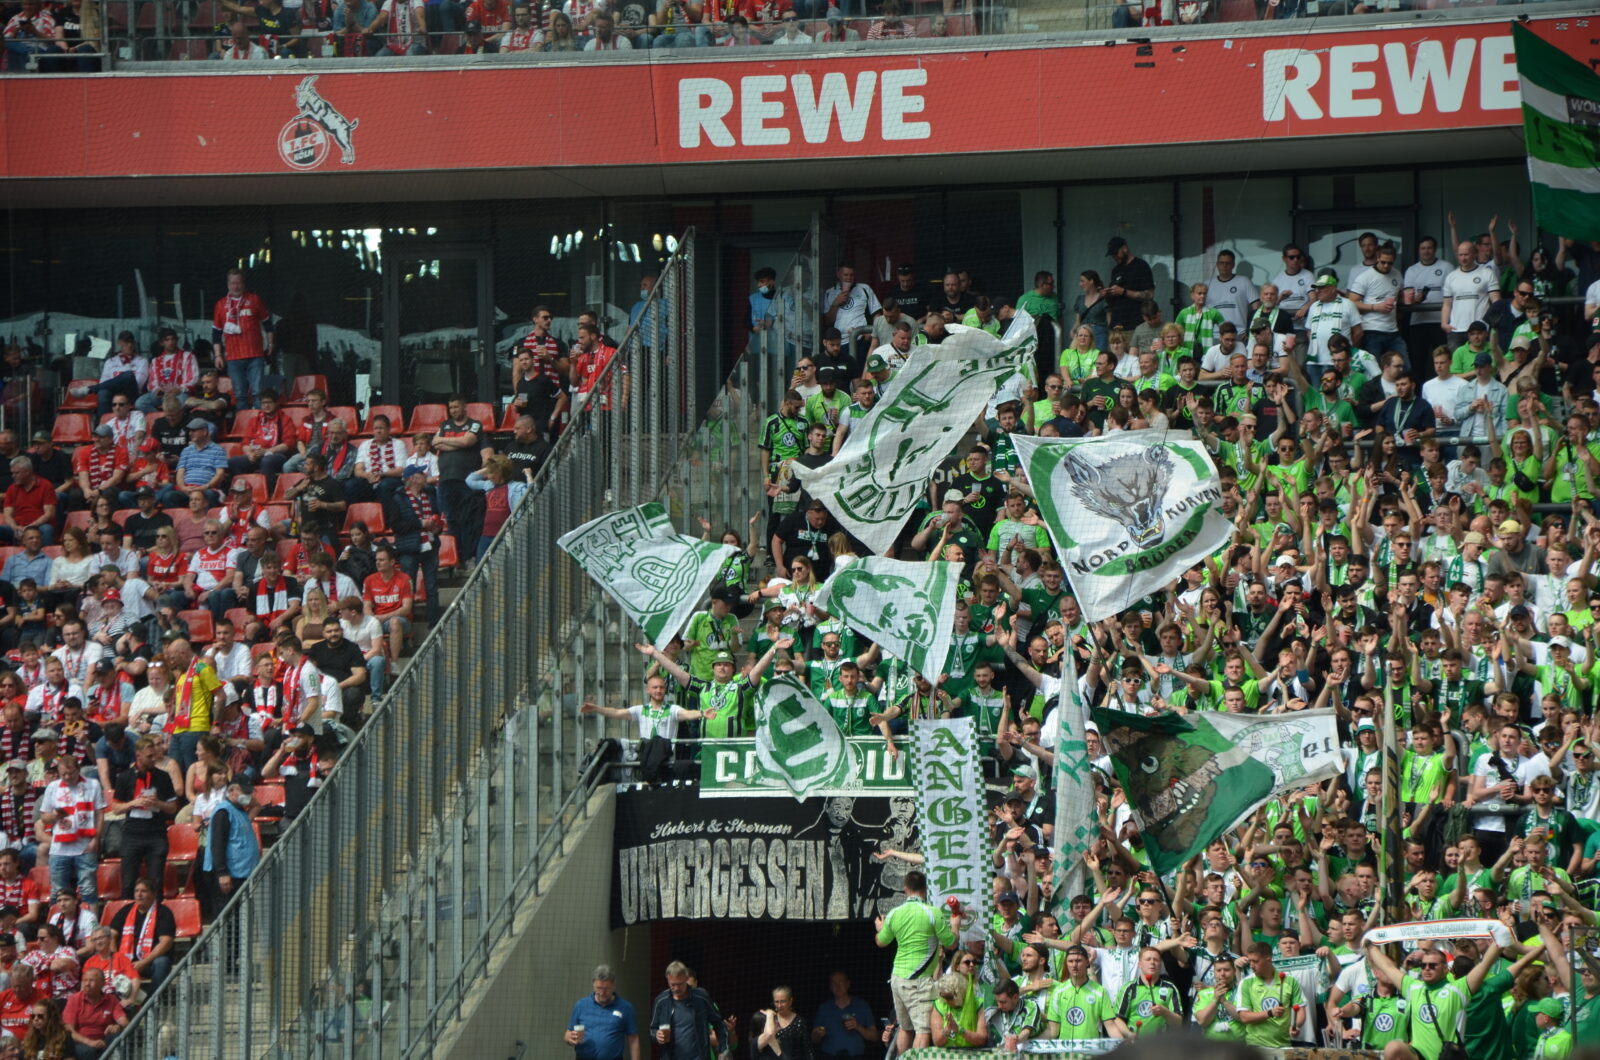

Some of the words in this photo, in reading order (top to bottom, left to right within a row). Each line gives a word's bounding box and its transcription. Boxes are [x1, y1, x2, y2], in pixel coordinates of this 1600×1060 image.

[678, 68, 931, 148] REWE
[1263, 36, 1522, 121] REWE
[1071, 541, 1130, 575] NORD
[1165, 487, 1222, 520] KURVEN
[1124, 529, 1198, 574] BRÜDER
[374, 594, 400, 604] REWE
[650, 820, 705, 840] Hubert
[707, 818, 723, 834] &
[724, 818, 793, 835] Sherman
[619, 838, 825, 925] UNVERGESSEN
